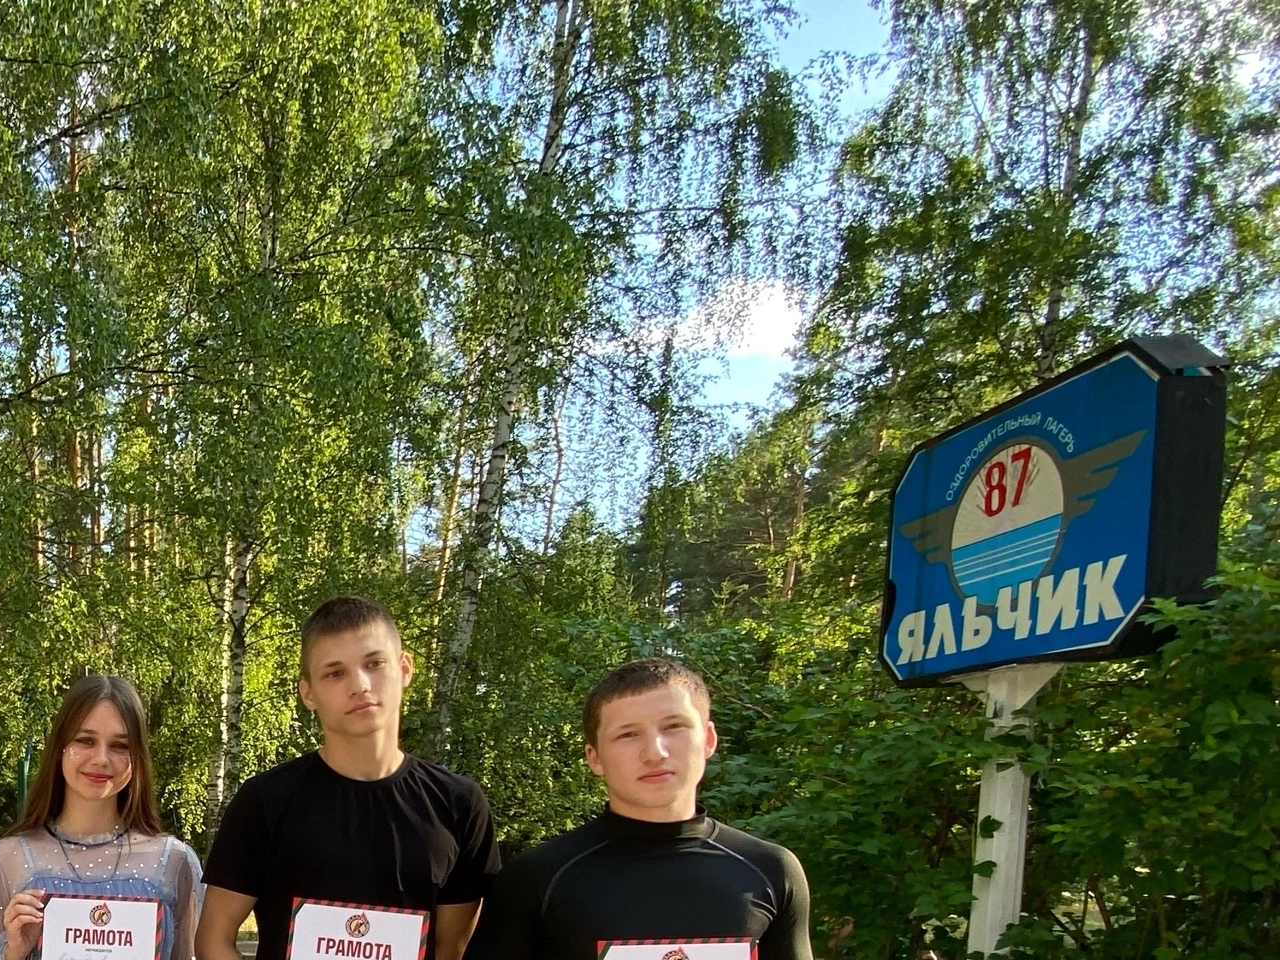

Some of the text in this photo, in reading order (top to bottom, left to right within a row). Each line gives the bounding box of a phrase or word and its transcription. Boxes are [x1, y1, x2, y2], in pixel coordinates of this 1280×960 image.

[945, 412, 1075, 501] ОЗДОРОВИТЕЛЬНЫЙ ЛАГЕРЬ
[984, 445, 1033, 517] 87
[896, 554, 1128, 665] ЯЛЬЧИК
[65, 927, 133, 947] ГРАМОТА
